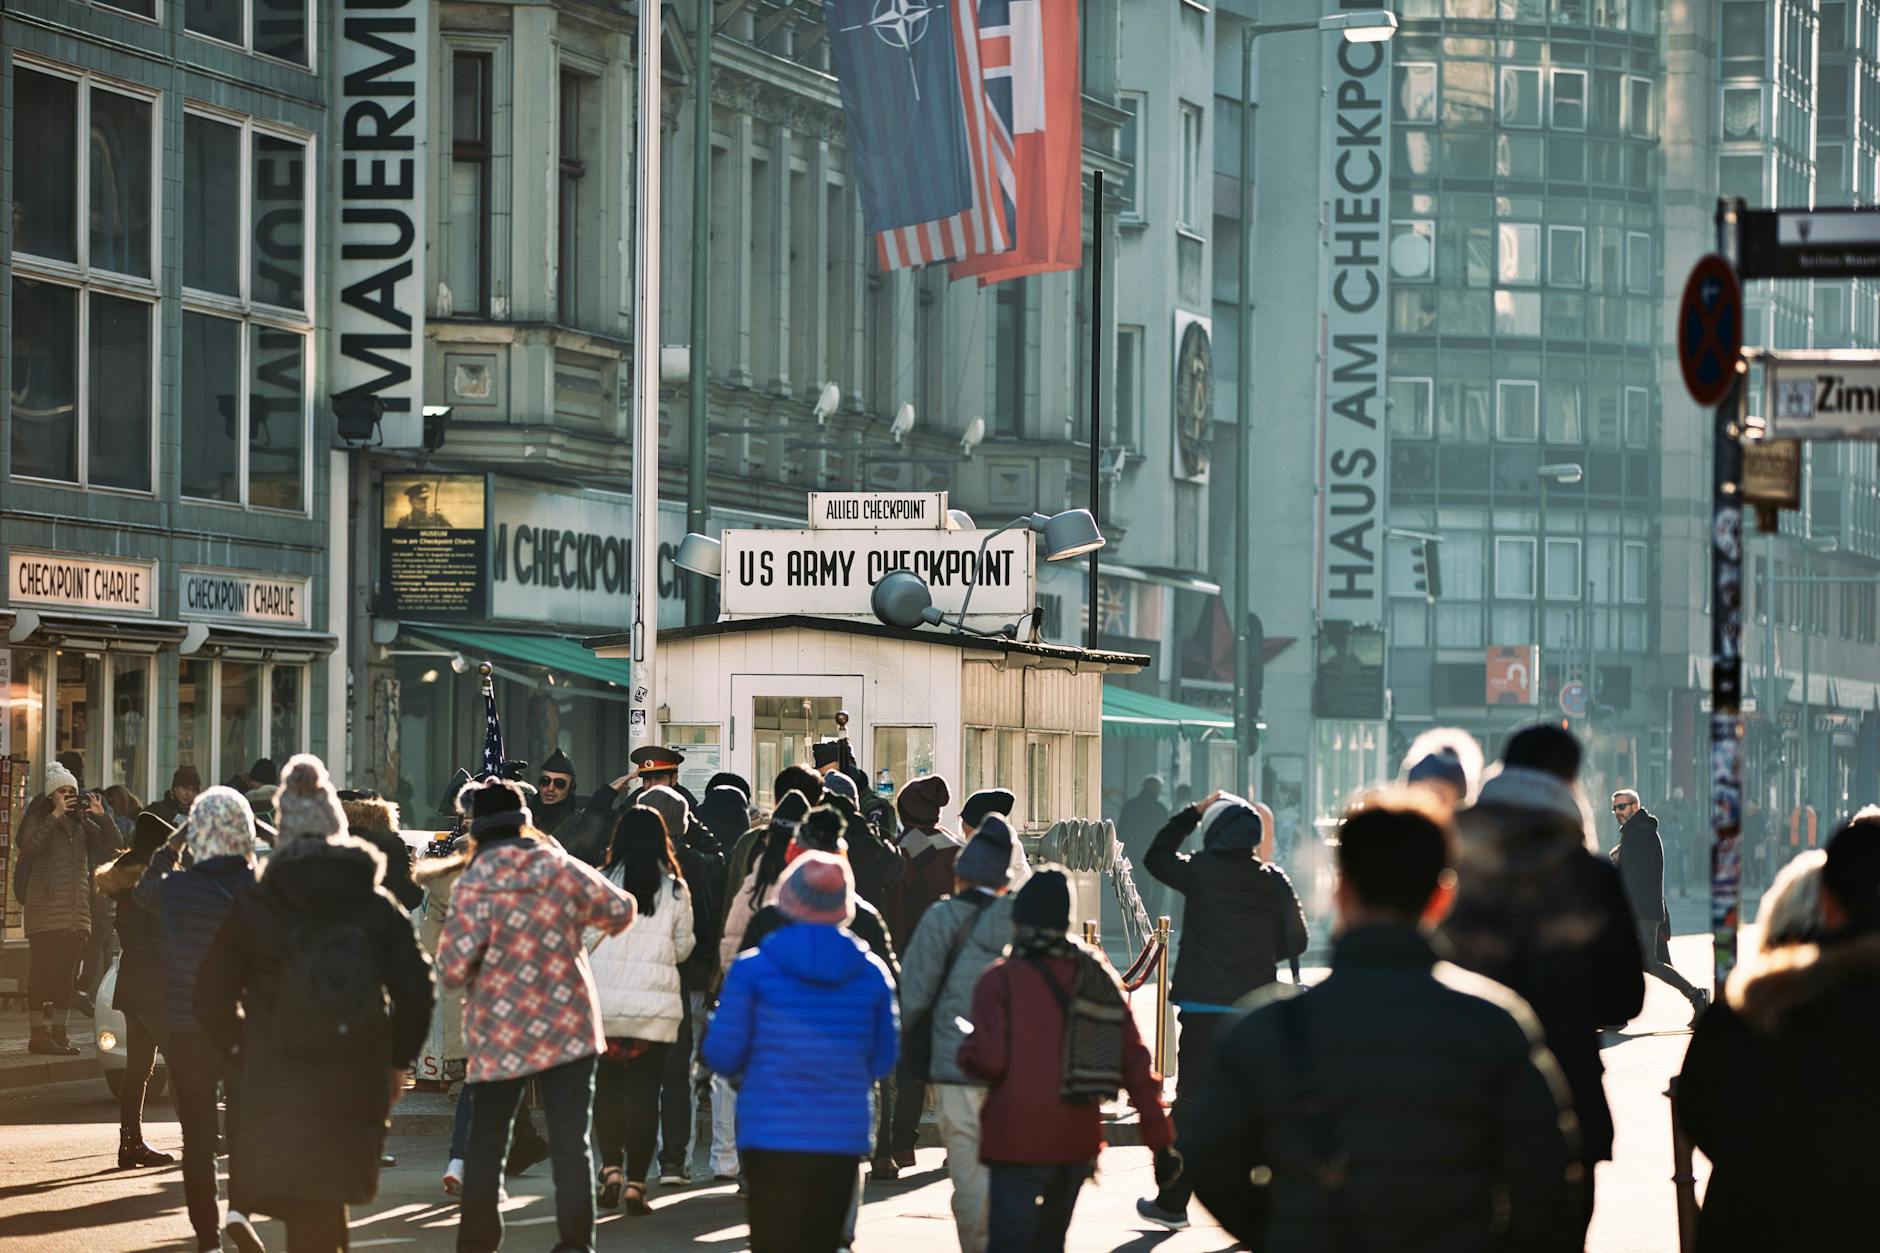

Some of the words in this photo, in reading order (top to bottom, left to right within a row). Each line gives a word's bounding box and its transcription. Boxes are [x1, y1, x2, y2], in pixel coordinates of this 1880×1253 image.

[341, 0, 416, 412] MAUERM
[1332, 334, 1378, 430] AM
[1816, 375, 1880, 413] Zim
[826, 500, 858, 519] ALLIED
[863, 499, 926, 519] CHECKPOINT
[1328, 448, 1377, 599] HAUS
[19, 562, 90, 599] CHECKPOINT
[94, 570, 140, 604] CHARLIE
[739, 550, 774, 586] US
[787, 550, 855, 586] ARMY
[187, 578, 250, 612] CHECKPOINT
[253, 585, 294, 616] CHARLIE
